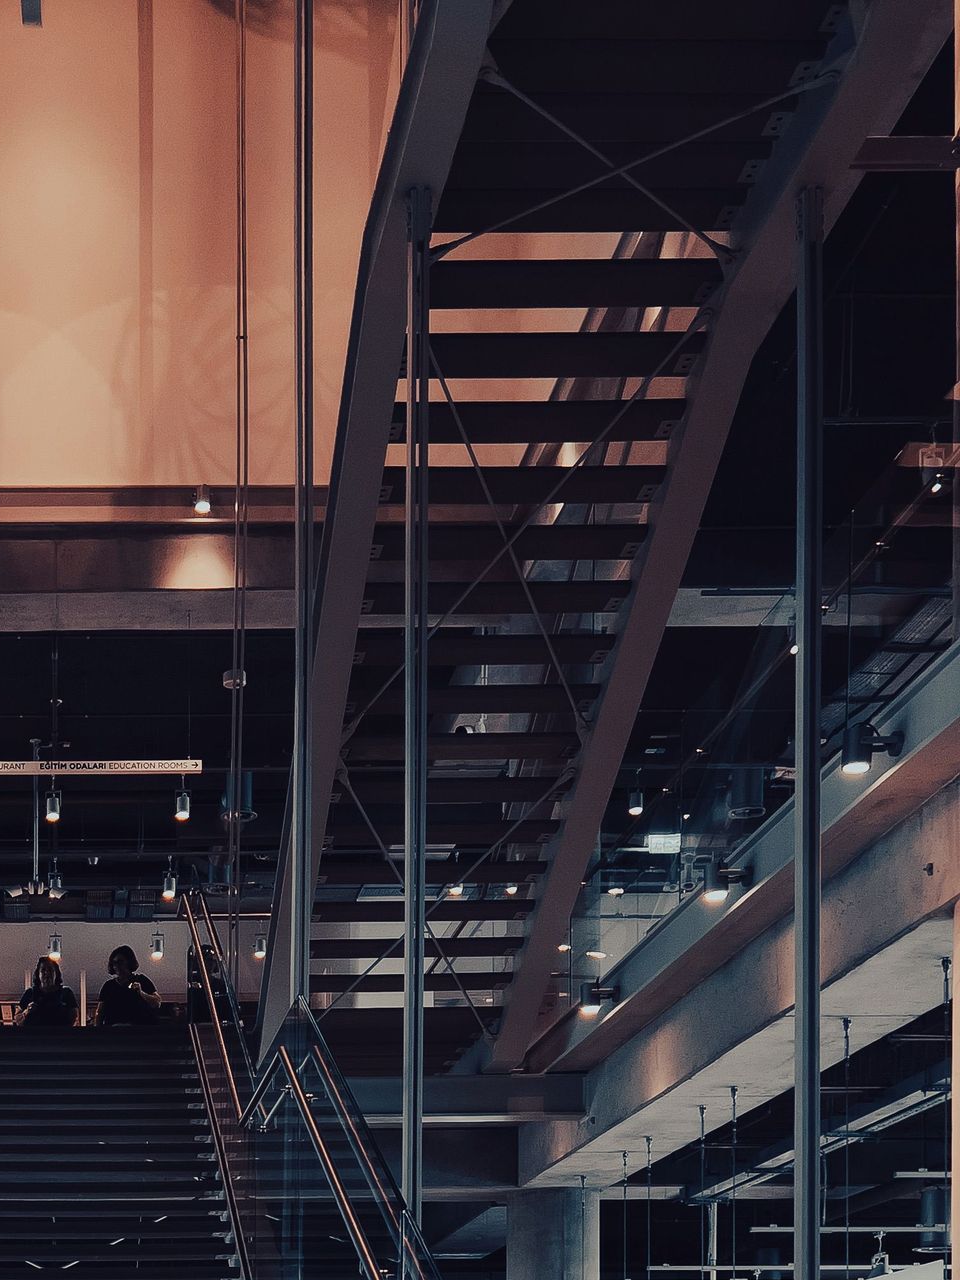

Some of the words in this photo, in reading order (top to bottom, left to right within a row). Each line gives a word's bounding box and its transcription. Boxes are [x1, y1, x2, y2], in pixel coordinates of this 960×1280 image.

[39, 760, 68, 770] EĞİTİM
[69, 762, 107, 770] ODALARI
[108, 762, 156, 770] EDUCATION
[158, 761, 188, 769] ROOMS
